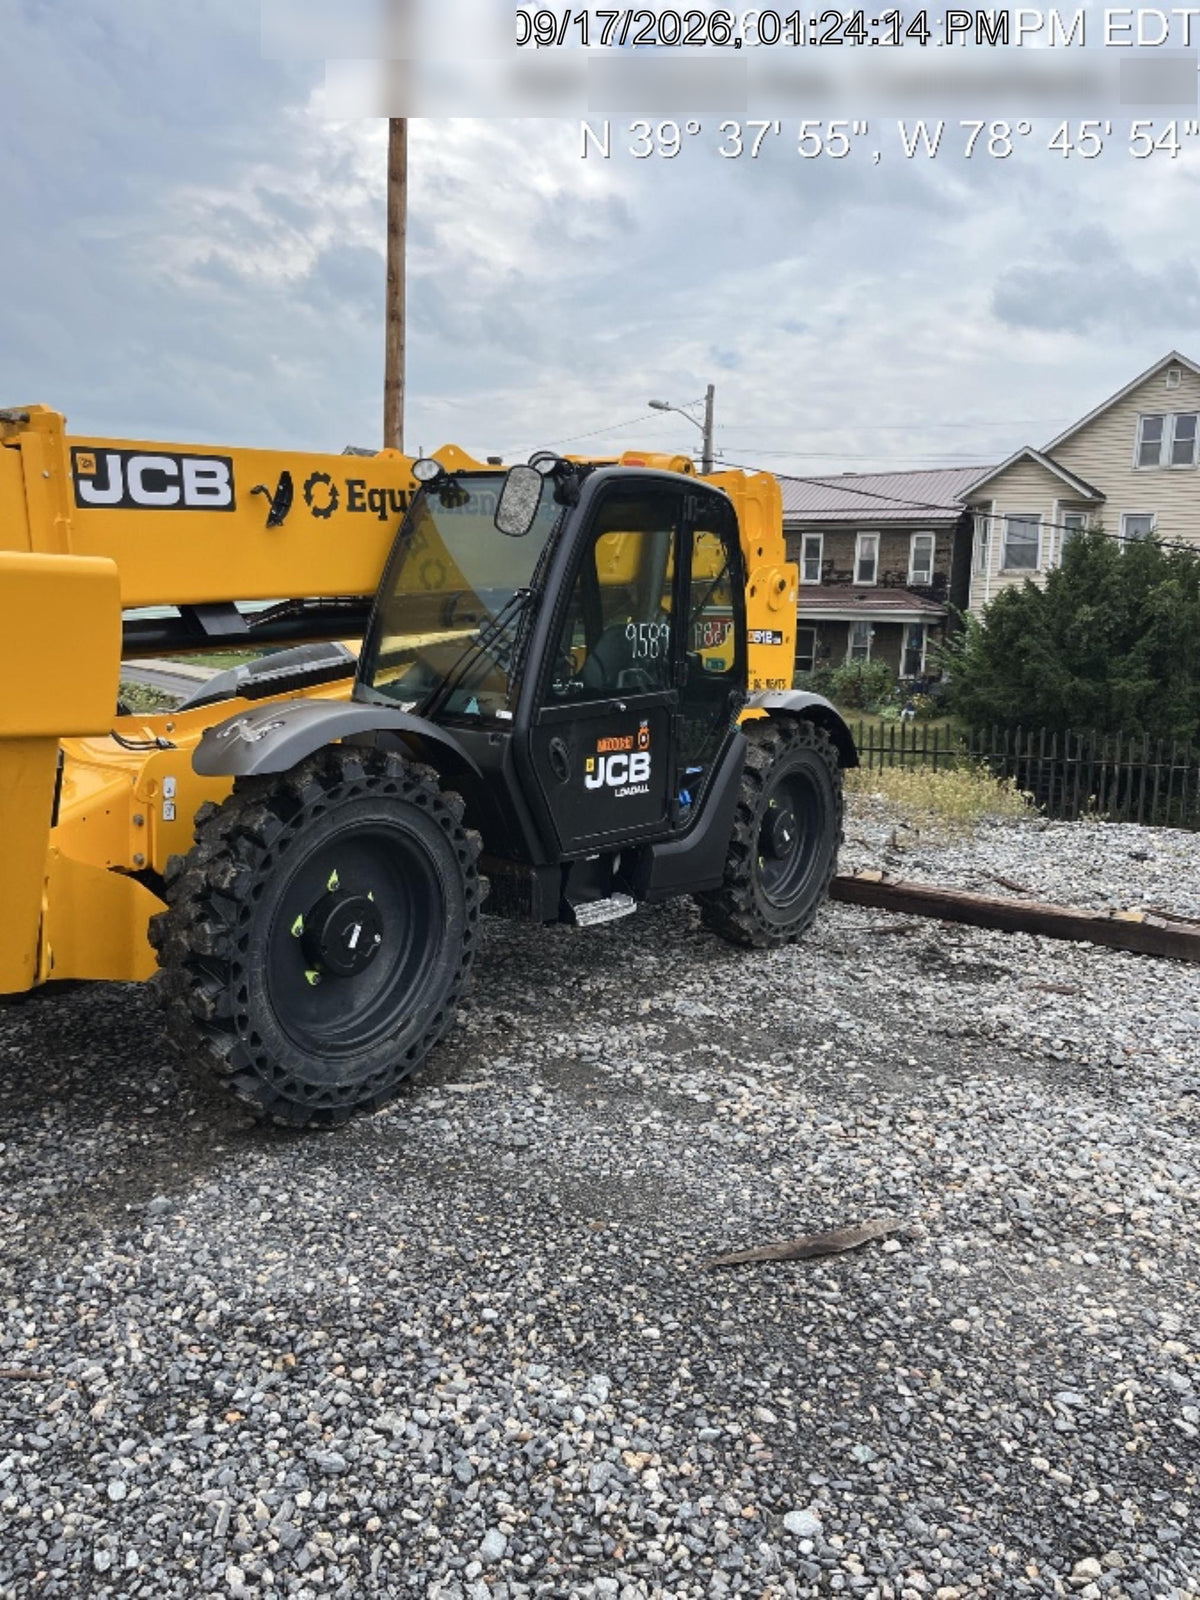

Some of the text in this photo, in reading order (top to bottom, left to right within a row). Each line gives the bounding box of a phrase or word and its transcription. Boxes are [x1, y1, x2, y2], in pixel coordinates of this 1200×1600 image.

[78, 453, 232, 506] JCB
[625, 622, 670, 659] 9589
[584, 751, 651, 790] JCB
